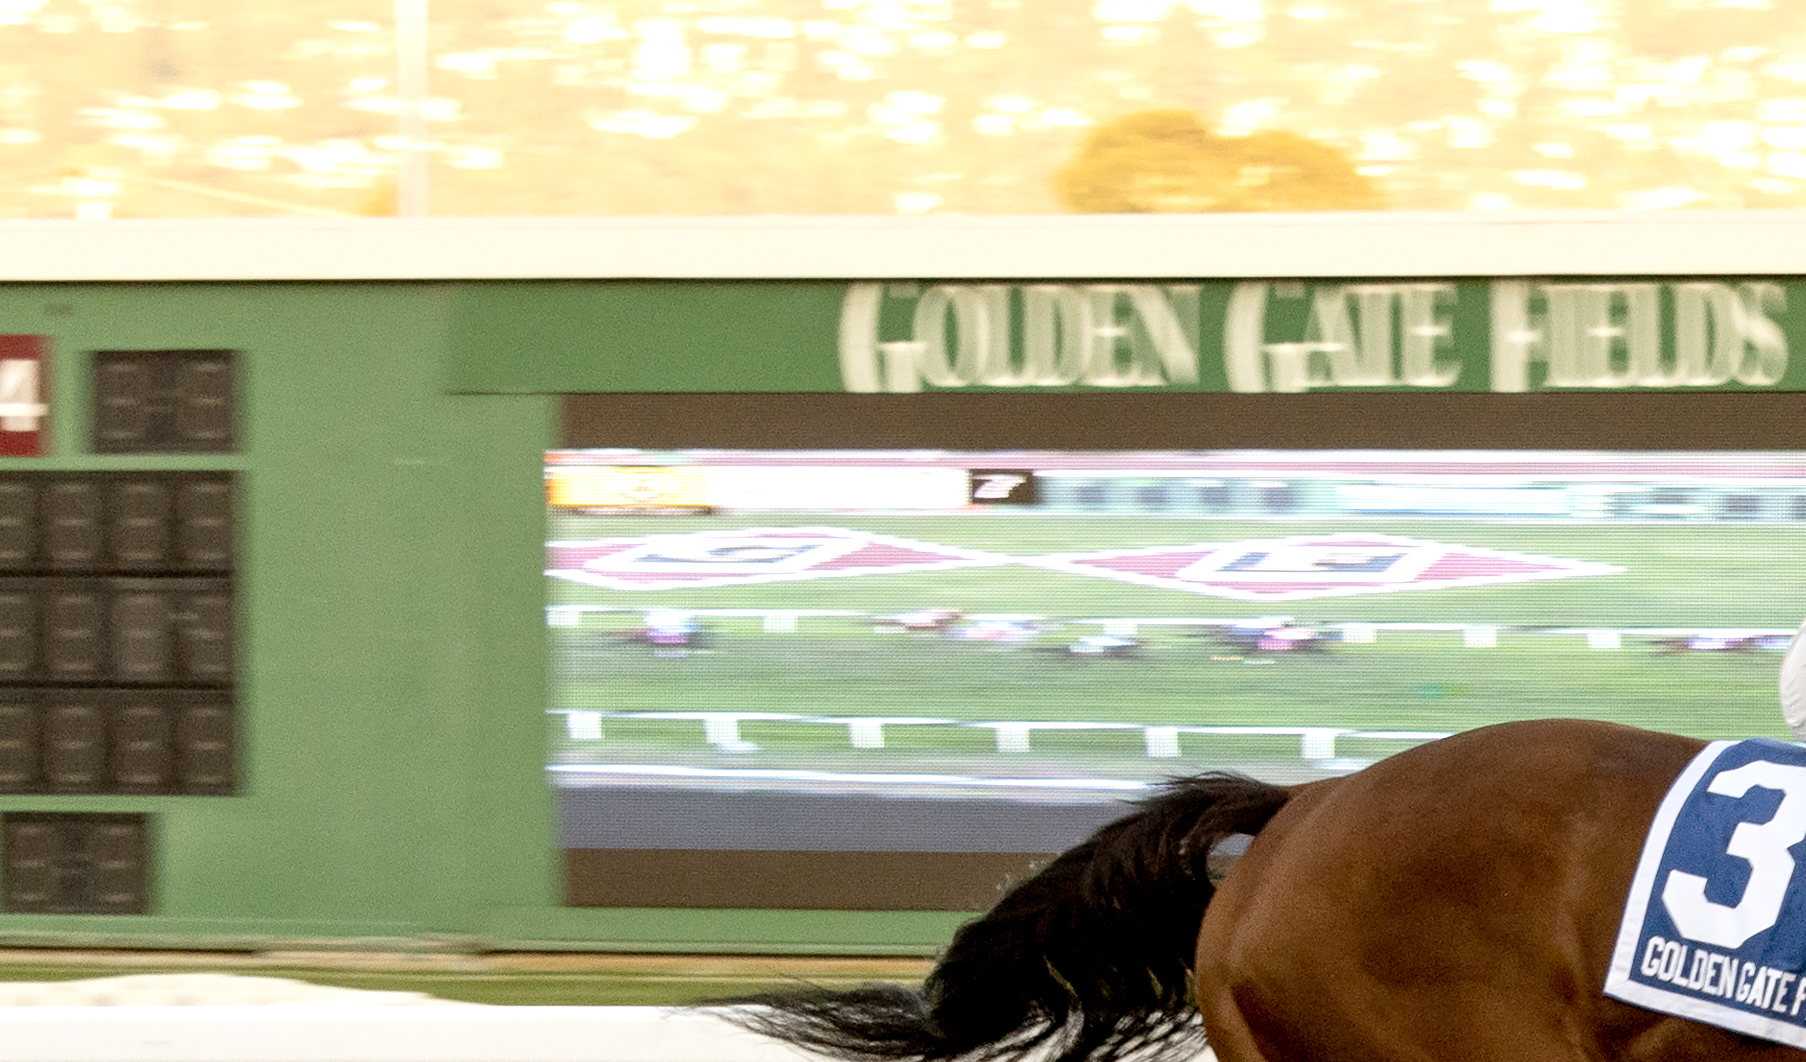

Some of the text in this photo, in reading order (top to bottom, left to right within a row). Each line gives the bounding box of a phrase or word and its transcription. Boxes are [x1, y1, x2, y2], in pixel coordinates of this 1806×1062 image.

[839, 280, 1789, 393] GOLDEN GATE FIELDS
[1640, 934, 1740, 999] GOLDEN
[1735, 961, 1798, 1014] GATE
